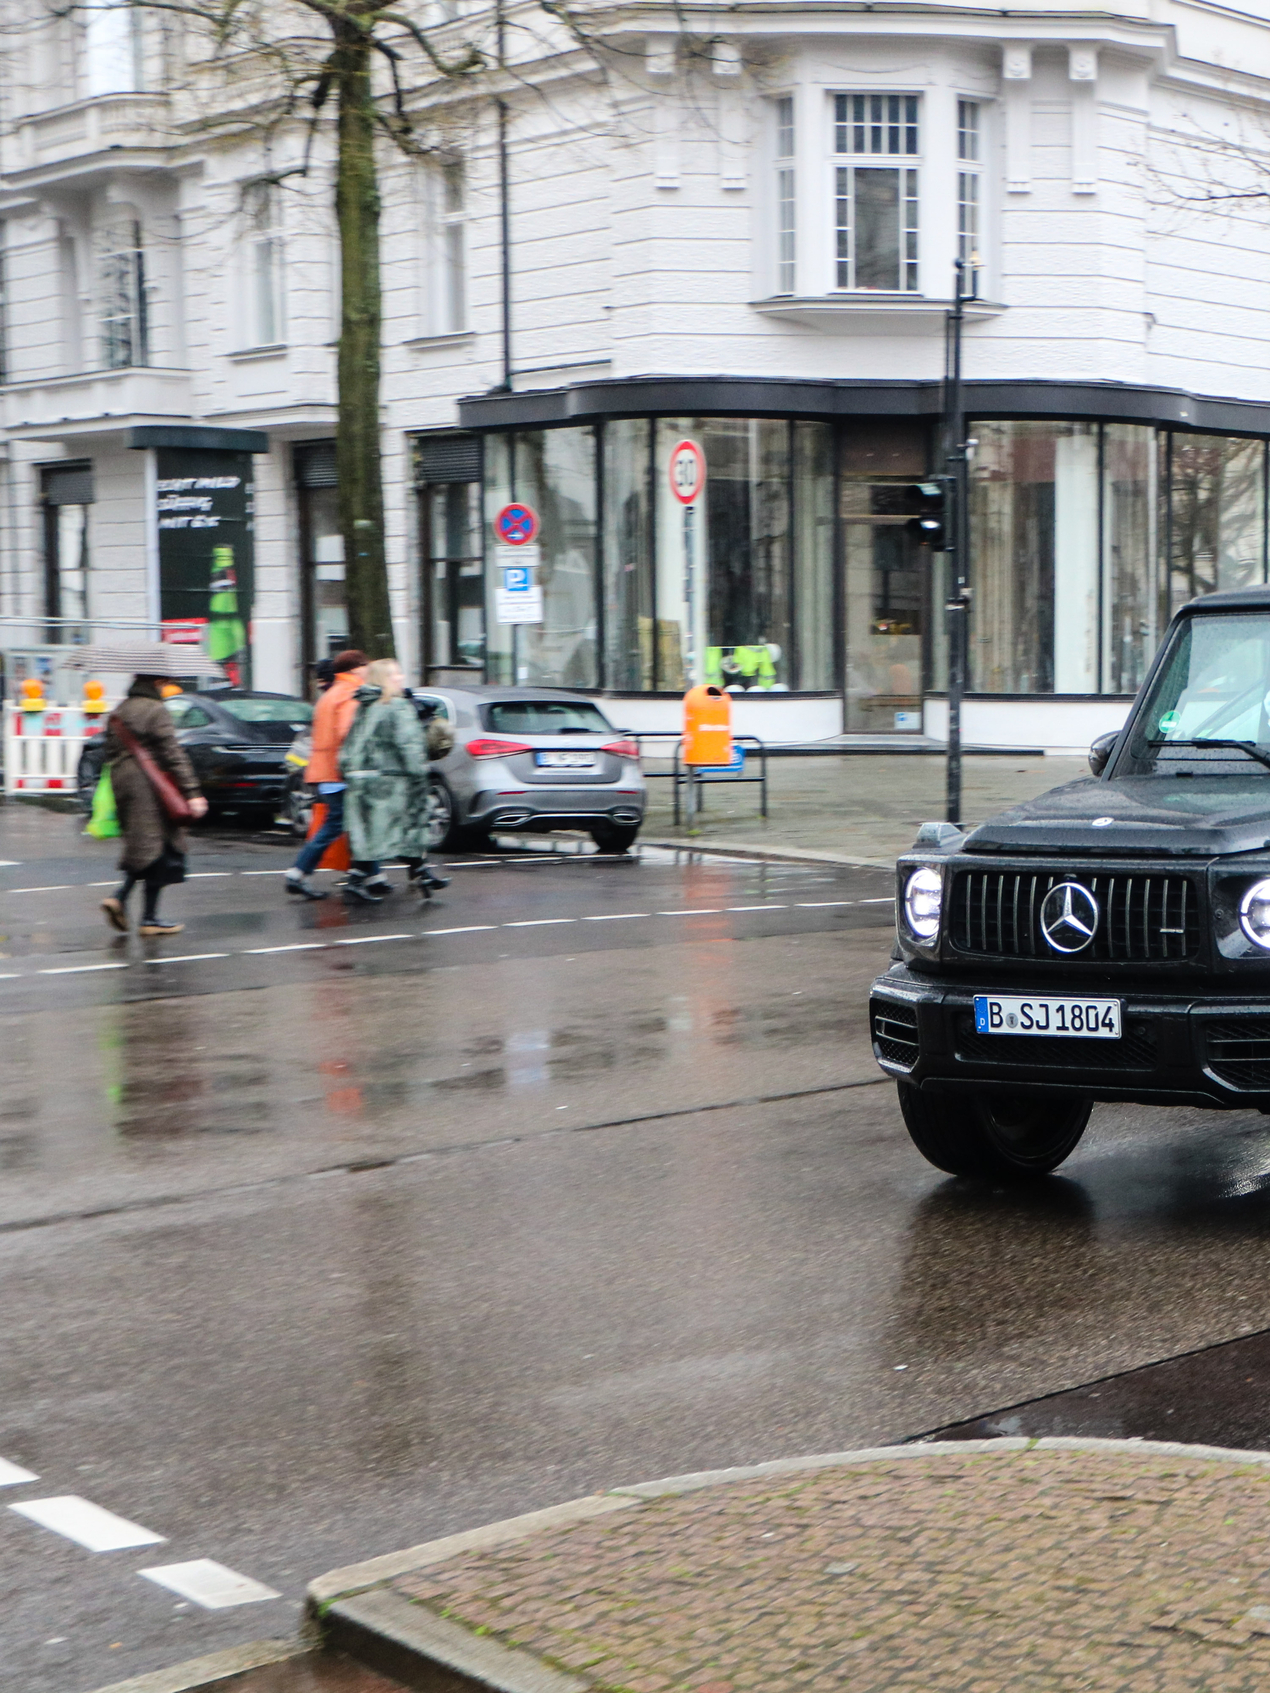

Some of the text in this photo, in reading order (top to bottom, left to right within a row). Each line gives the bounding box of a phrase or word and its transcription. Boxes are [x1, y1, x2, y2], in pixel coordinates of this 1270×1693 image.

[676, 459, 695, 487] 30
[507, 569, 526, 588] P
[989, 1002, 1003, 1028] B
